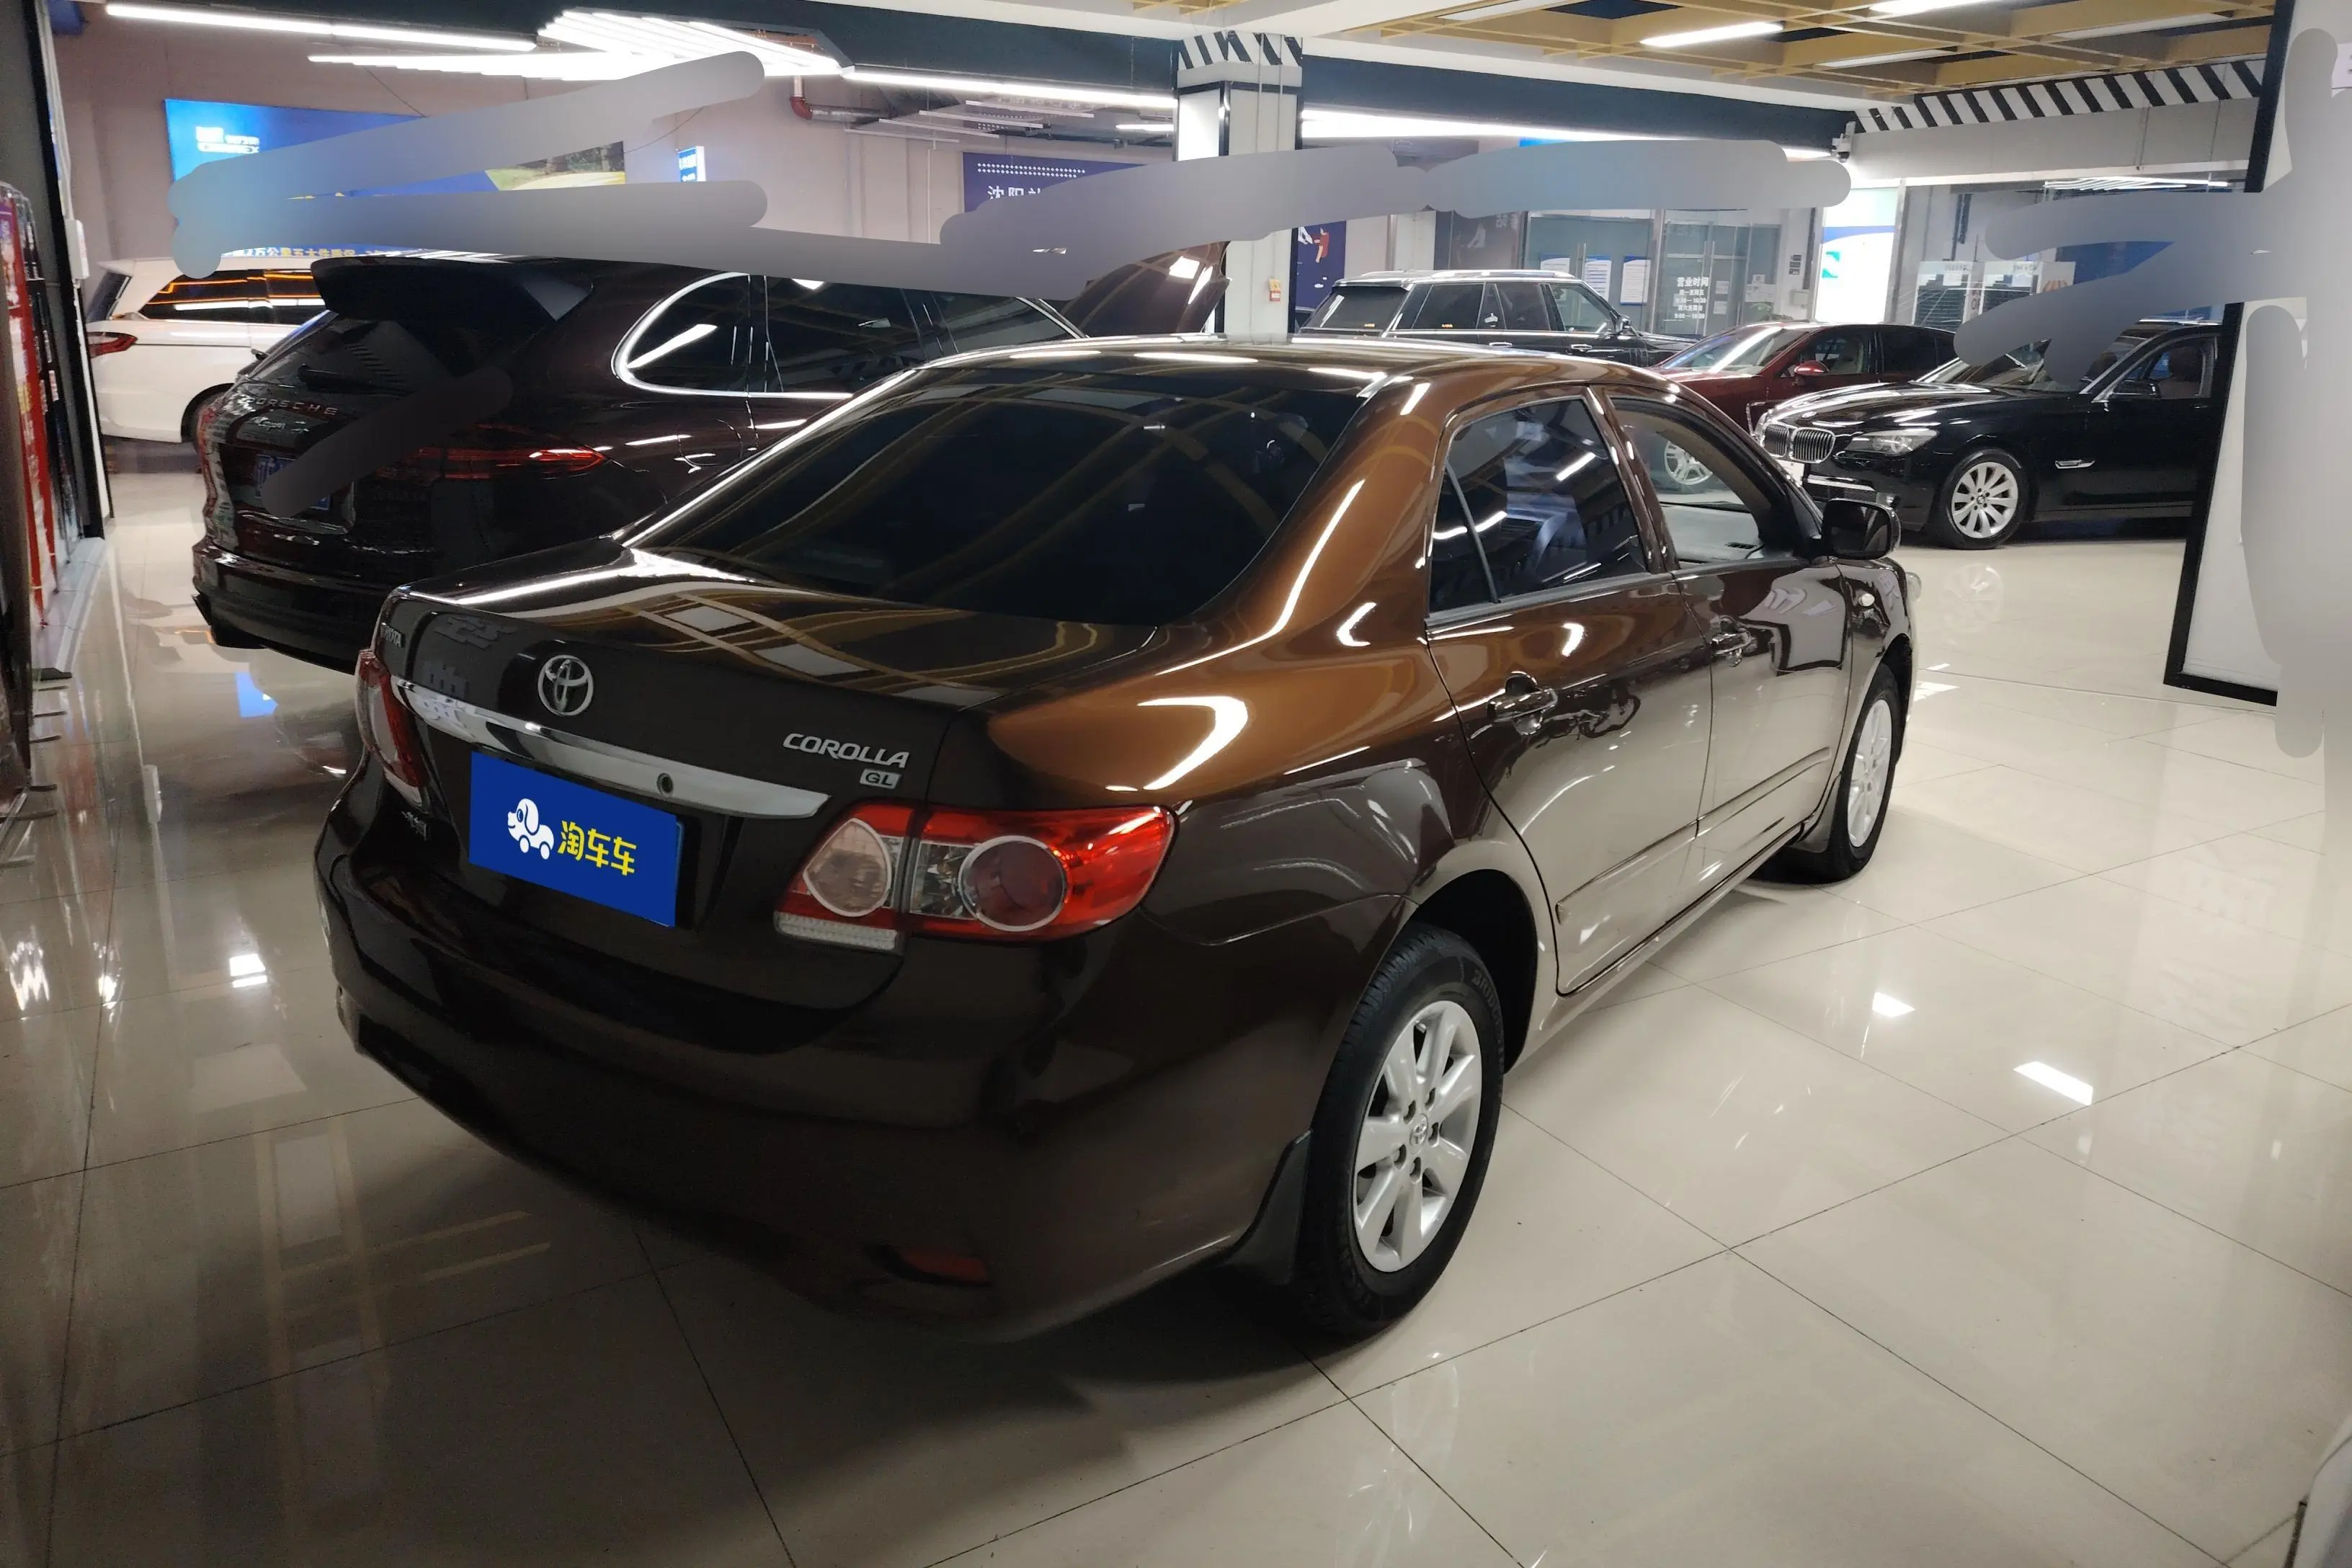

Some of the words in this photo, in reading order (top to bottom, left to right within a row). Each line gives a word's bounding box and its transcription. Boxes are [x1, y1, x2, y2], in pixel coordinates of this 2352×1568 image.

[1677, 277, 1709, 287] 营业时间
[783, 733, 910, 768] COROLLA
[863, 770, 896, 788] GL
